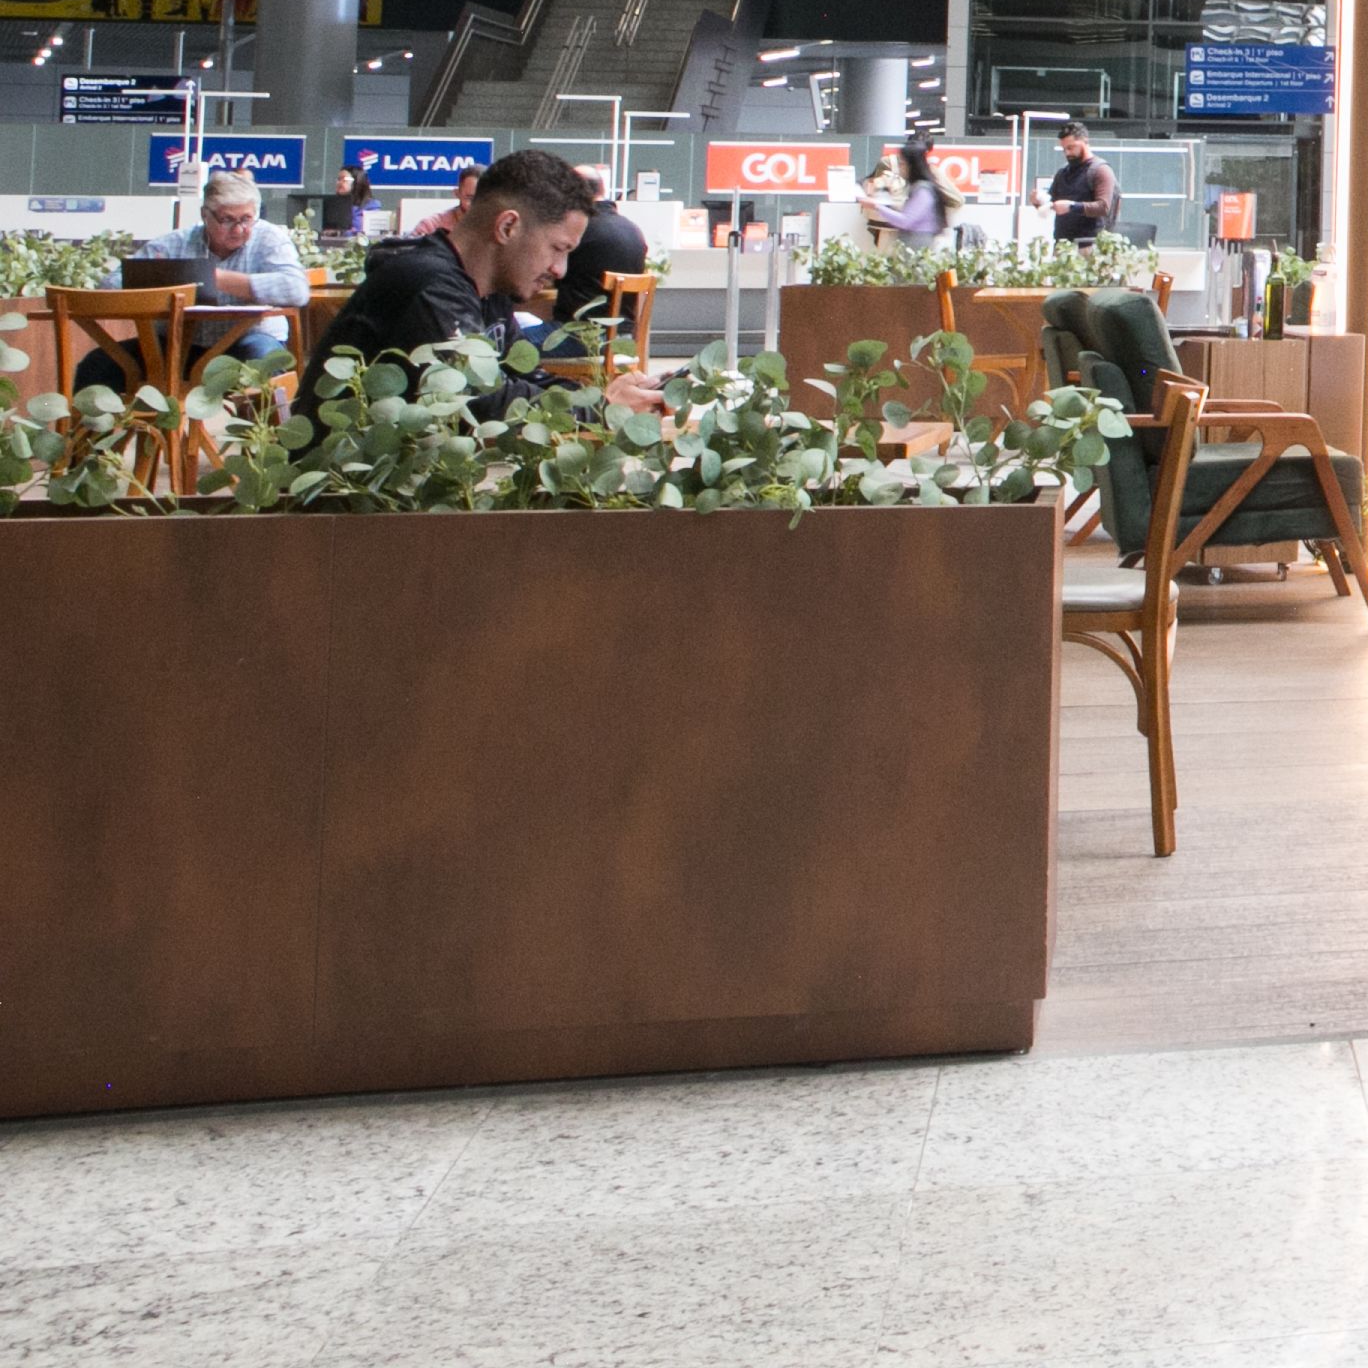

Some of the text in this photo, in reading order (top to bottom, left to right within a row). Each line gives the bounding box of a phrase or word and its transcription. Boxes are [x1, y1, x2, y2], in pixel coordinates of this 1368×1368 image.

[1206, 93, 1262, 103] Desembarque
[384, 155, 475, 171] LATAM
[742, 153, 816, 183] GOL
